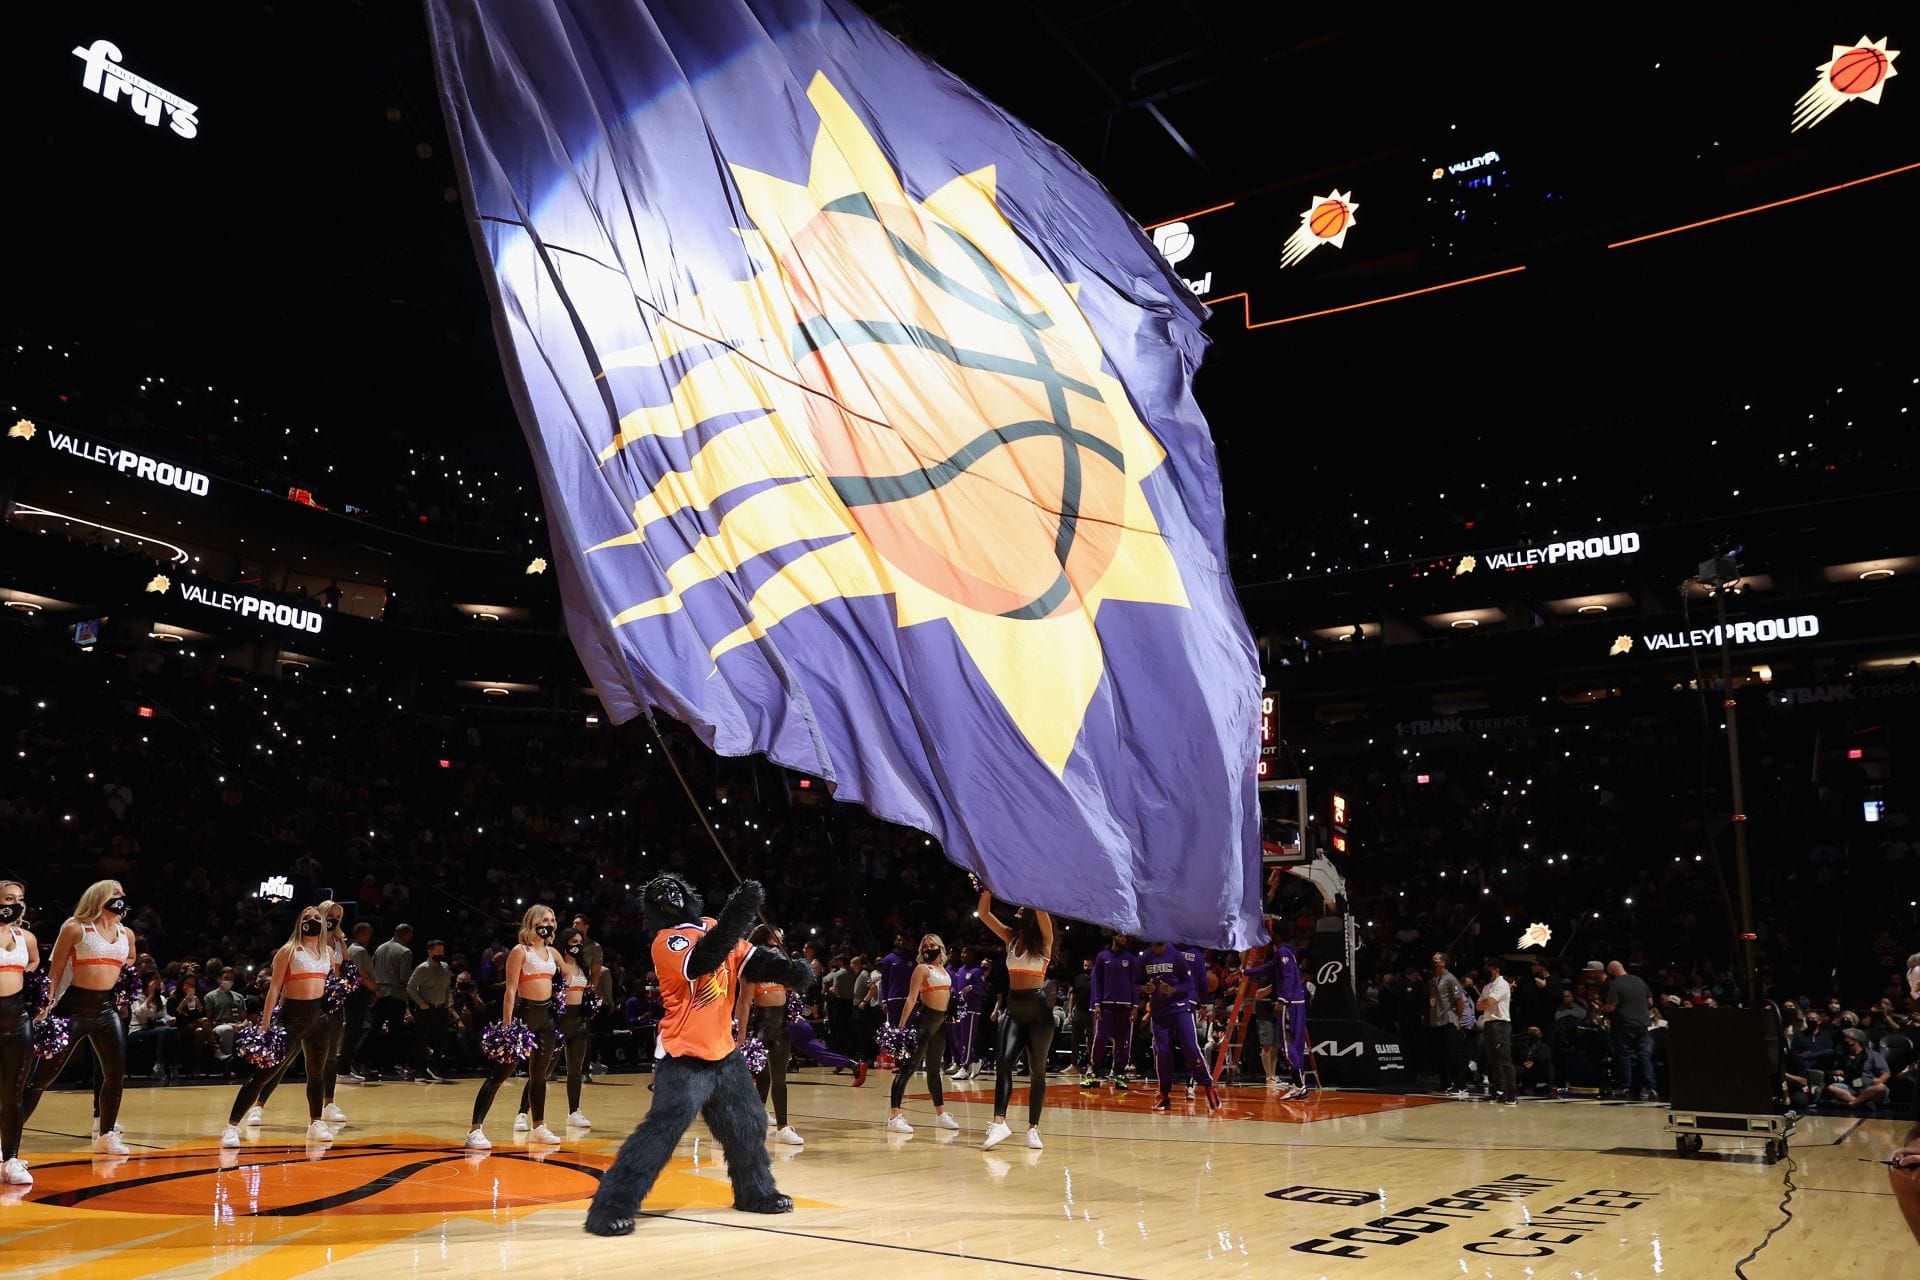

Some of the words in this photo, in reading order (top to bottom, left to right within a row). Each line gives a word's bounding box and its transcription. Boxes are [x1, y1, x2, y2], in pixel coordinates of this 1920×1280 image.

[72, 39, 199, 139] fry's
[1145, 963, 1173, 974] SAC
[1290, 1174, 1565, 1259] FOOTPRINT
[1463, 1189, 1660, 1258] CENTER
